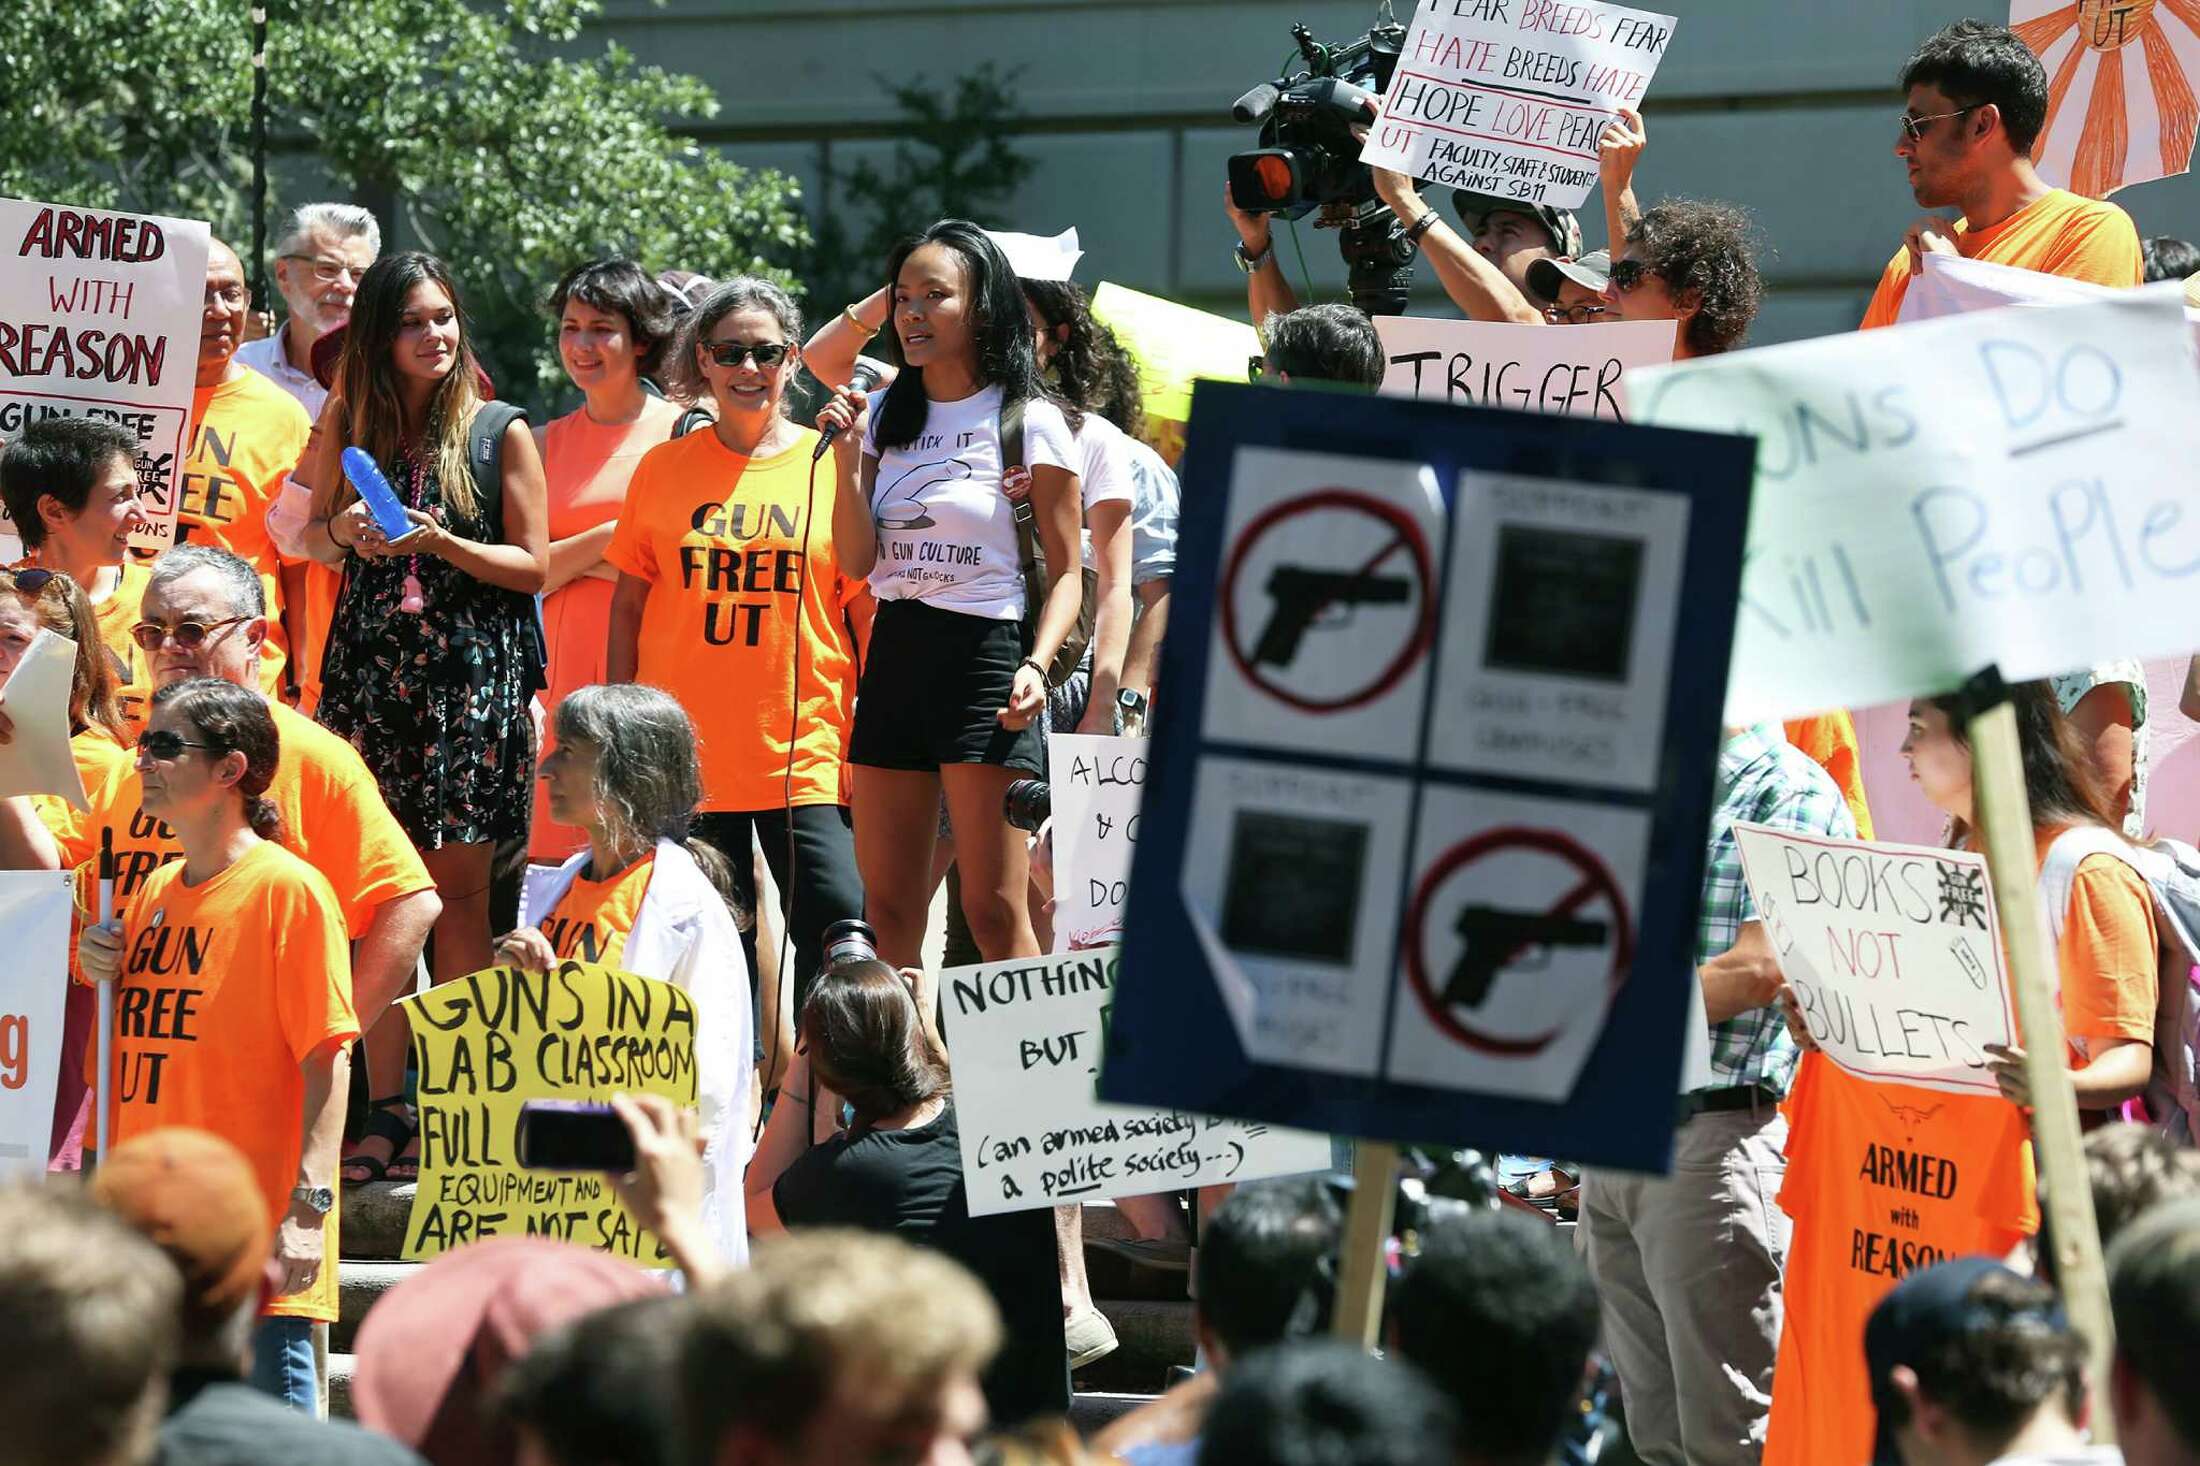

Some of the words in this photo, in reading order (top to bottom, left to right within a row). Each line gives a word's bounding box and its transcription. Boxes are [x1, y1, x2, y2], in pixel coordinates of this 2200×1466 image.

[1519, 0, 1603, 39] BREEDS
[1610, 17, 1668, 54] FEAR
[2094, 7, 2134, 47] UT
[1415, 29, 1500, 73] HATE
[1503, 46, 1582, 87] BREEDS
[1582, 63, 1647, 101] HATE
[1394, 78, 1486, 127] HOPE
[1491, 100, 1556, 142] LOVE
[1381, 126, 1423, 154] UT
[1503, 156, 1538, 178] STAFF
[1507, 180, 1547, 202] SB11
[18, 207, 165, 263] ARMED
[49, 275, 134, 320] WITH
[0, 323, 167, 387] REASON
[1390, 351, 1624, 424] TRIGGER
[1976, 339, 2124, 432] DO
[956, 432, 975, 449] IT
[136, 470, 160, 483] REE
[134, 521, 169, 538] UNS
[691, 502, 800, 539] GUN
[680, 546, 803, 595] FREE
[892, 541, 914, 561] GUN
[918, 541, 983, 566] CULTURE
[704, 603, 771, 647] UT
[1783, 845, 1933, 925] BOOKS
[128, 926, 214, 975] GUN
[1825, 925, 1902, 979] NOT
[411, 961, 587, 1035] GUNS
[604, 970, 651, 1033] IN
[661, 983, 695, 1037] A
[1795, 979, 1985, 1069] BULLETS
[417, 1030, 518, 1095] LAB
[536, 1032, 698, 1101] CLASSROOM
[1020, 1030, 1087, 1071] BUT
[121, 1051, 169, 1105] UT
[421, 1102, 503, 1169] FULL
[1040, 1119, 1121, 1156] armed
[440, 1173, 573, 1207] EQUIPMENT
[575, 1175, 601, 1200] AND
[1001, 1173, 1023, 1199] a
[1040, 1154, 1116, 1197] polite
[1859, 1141, 1958, 1200] ARMED
[1890, 1205, 1920, 1231] with
